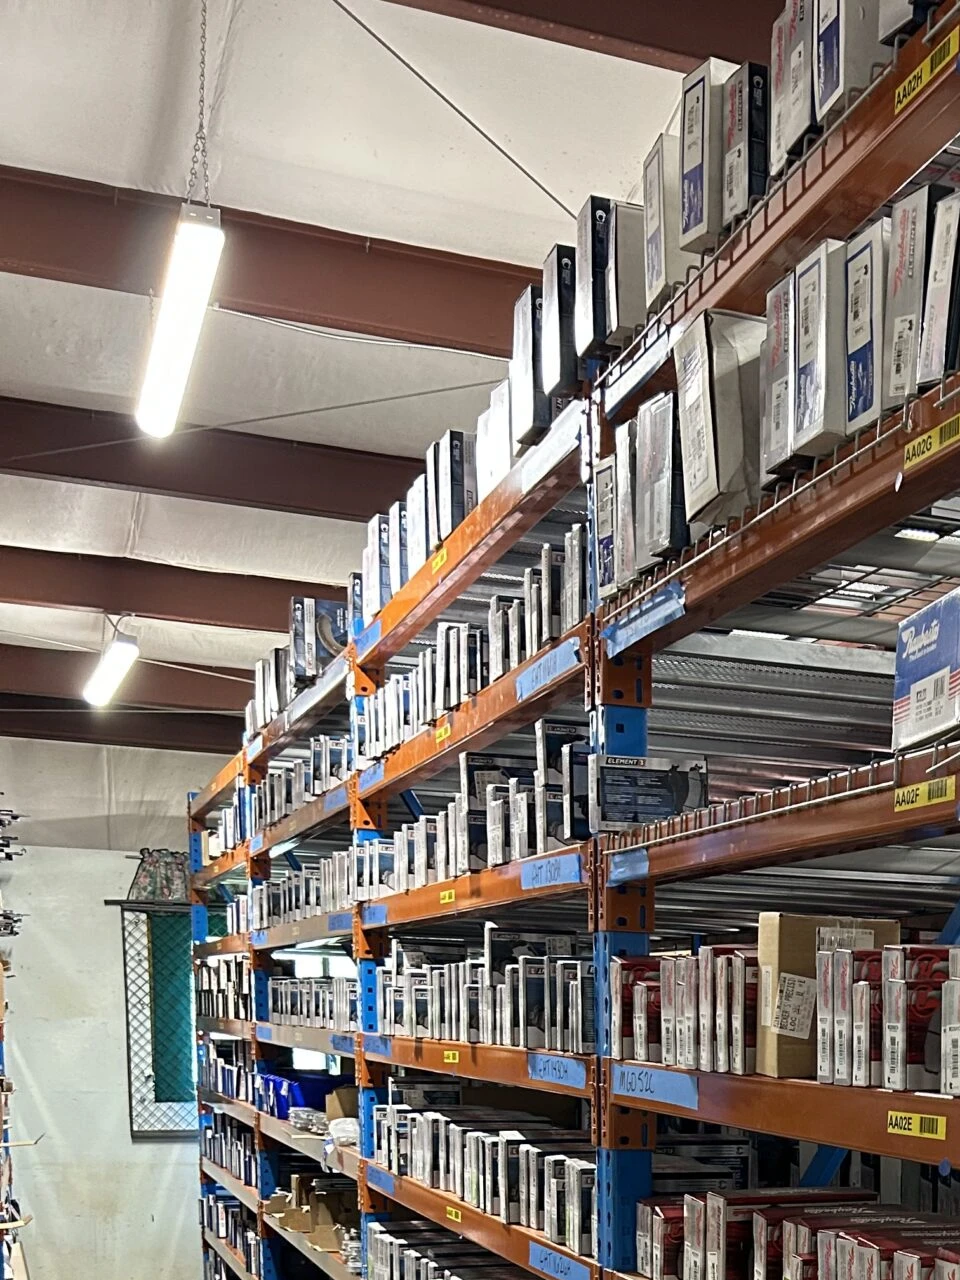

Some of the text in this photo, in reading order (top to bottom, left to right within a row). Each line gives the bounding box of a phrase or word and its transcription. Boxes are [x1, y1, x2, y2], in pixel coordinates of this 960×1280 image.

[895, 70, 923, 107] AA02H
[904, 434, 933, 464] AA02G
[901, 618, 940, 659] Raybestos
[608, 757, 637, 765] ELEMENT
[895, 790, 920, 808] AA02F
[789, 1016, 798, 1032] LOC
[888, 1111, 912, 1131] AA02E
